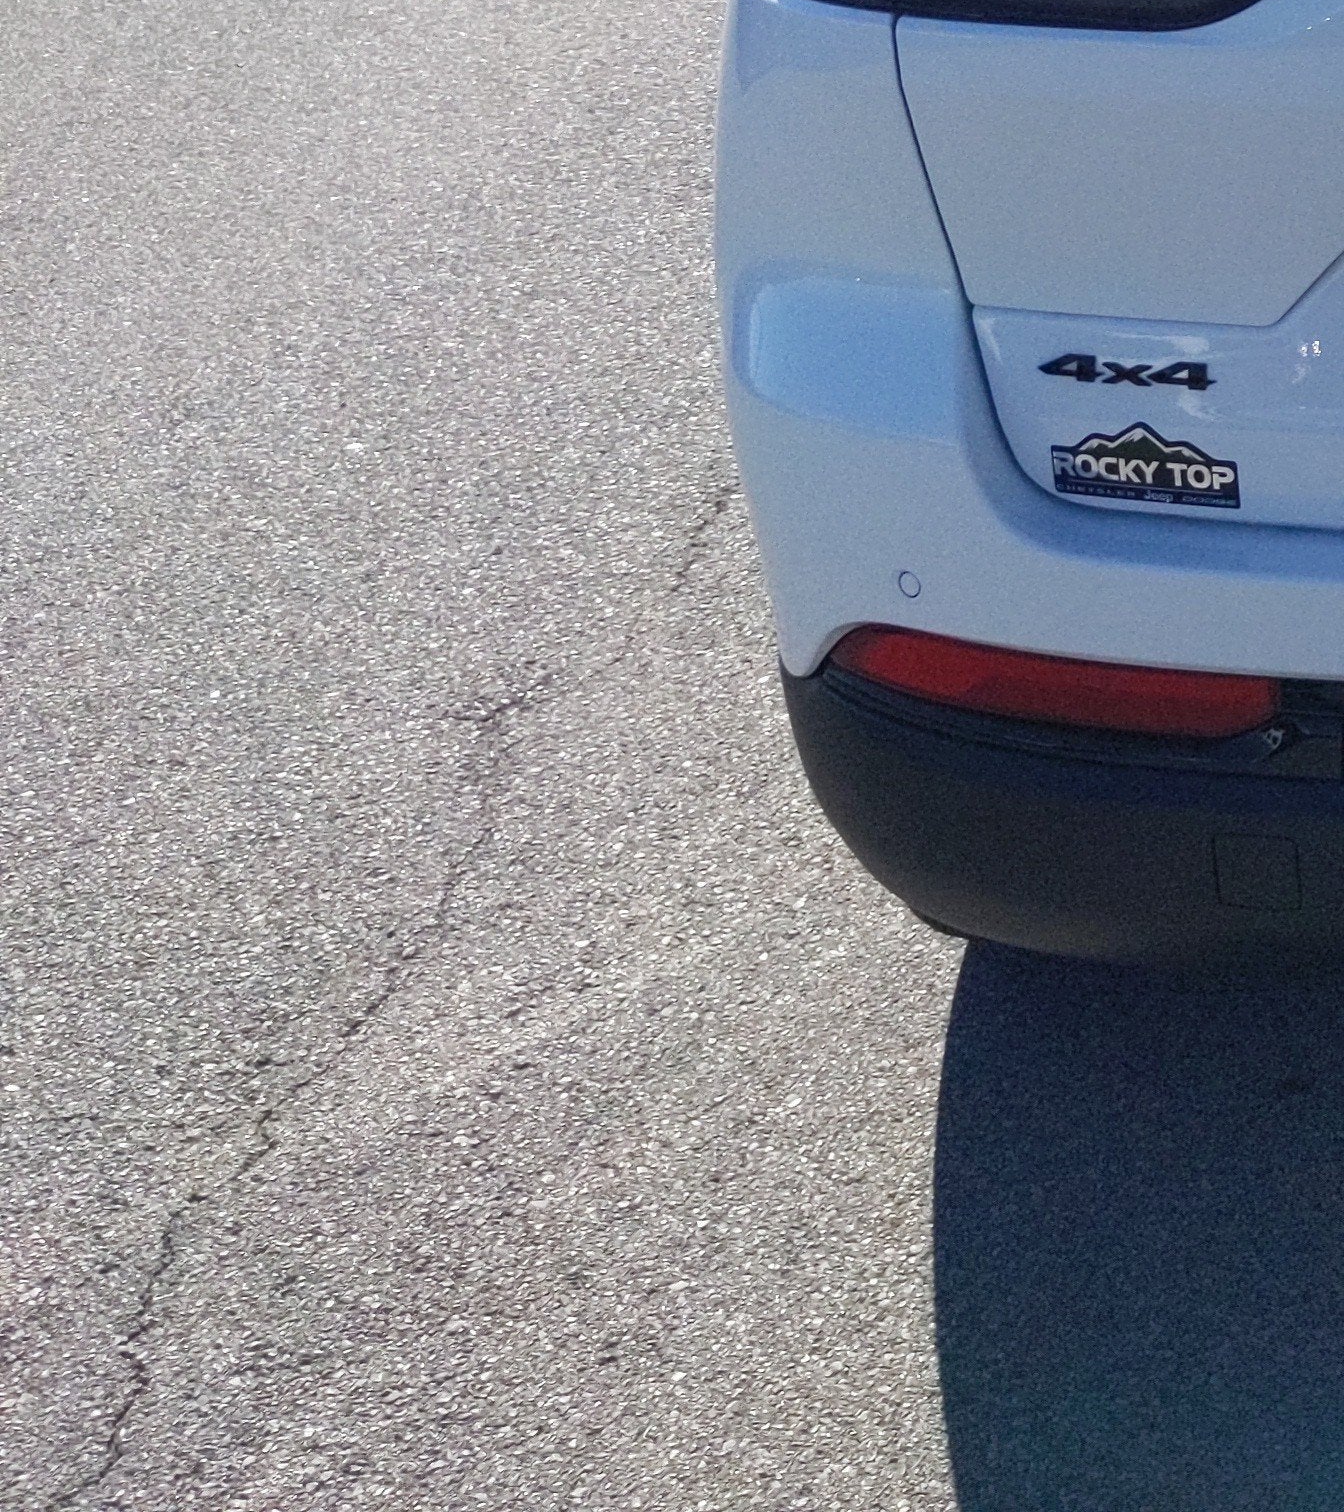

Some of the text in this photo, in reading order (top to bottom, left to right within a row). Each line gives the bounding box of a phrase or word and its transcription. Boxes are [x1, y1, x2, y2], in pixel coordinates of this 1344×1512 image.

[1038, 353, 1218, 390] 4x4
[1053, 451, 1236, 491] ROCKY TOP
[1144, 490, 1174, 503] Jeep
